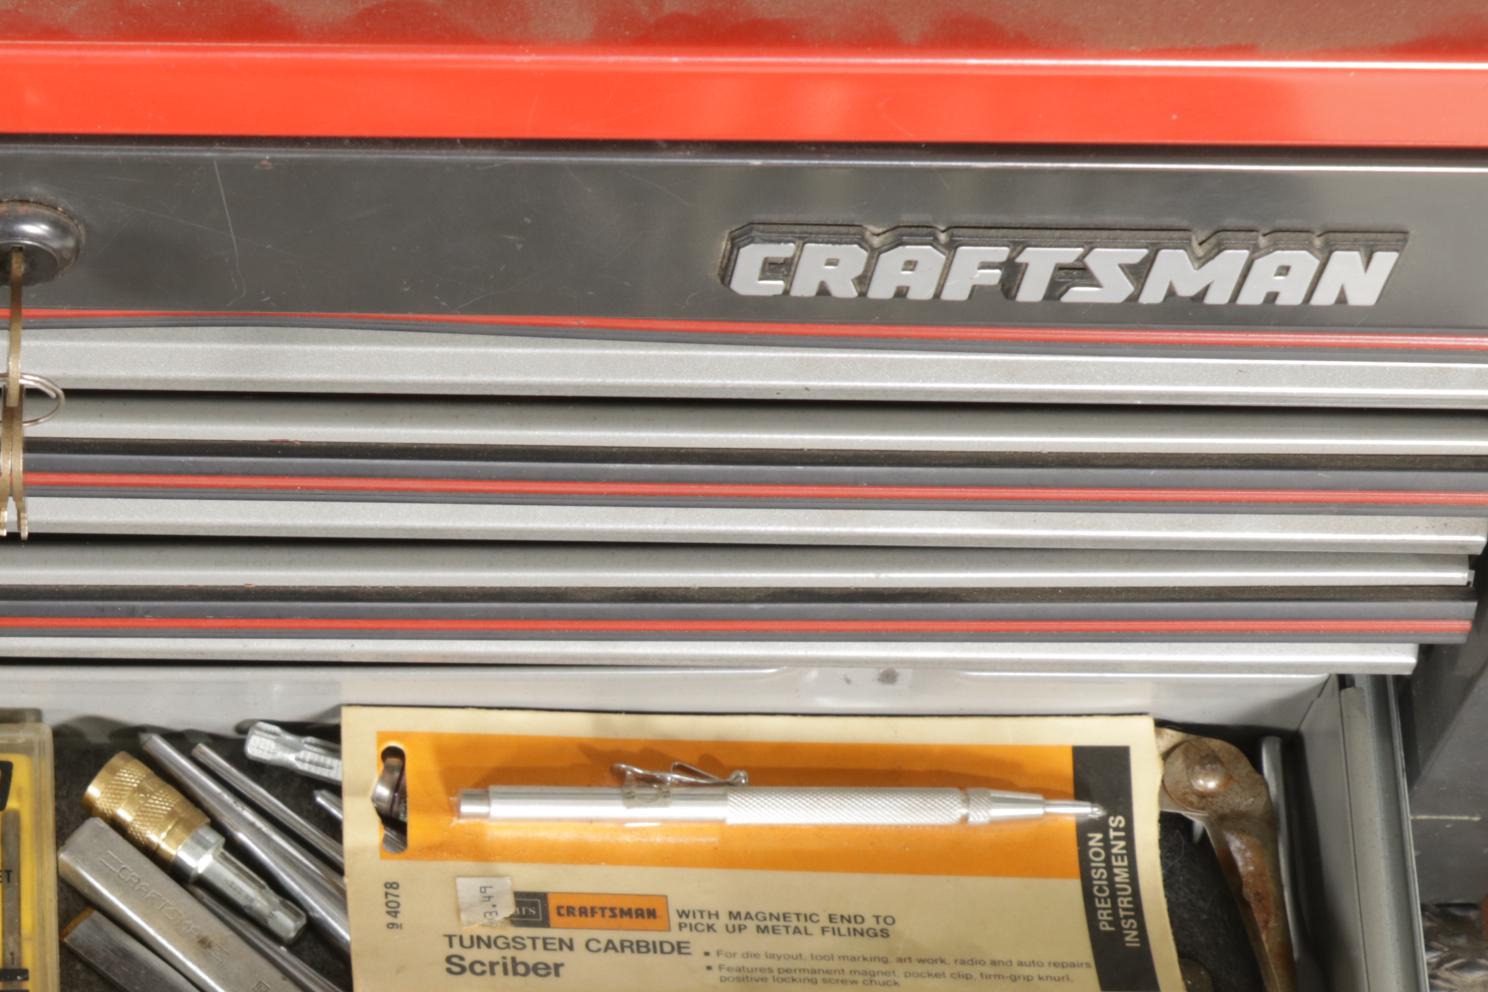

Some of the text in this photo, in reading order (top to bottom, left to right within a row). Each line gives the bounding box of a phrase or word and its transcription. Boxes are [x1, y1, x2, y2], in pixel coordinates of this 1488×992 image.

[724, 232, 1403, 307] CRAFTSMAN
[1097, 832, 1116, 932] PRECISION
[1110, 815, 1142, 948] INSTRUMENTS
[384, 881, 400, 918] 4078
[556, 904, 657, 920] CRAFTSMAN
[676, 909, 896, 926] WITH MAGNETIC END TO
[678, 921, 890, 938] PICK UP METAL FILINGS
[443, 933, 692, 956] TUNGSTEN CARBIDE
[445, 953, 564, 979] Scriber
[716, 949, 1091, 971] For die tool art radio and auto repairs
[717, 962, 1033, 983] Features permanent pocket firm-grip
[719, 974, 900, 987] positive locking screw chuck
